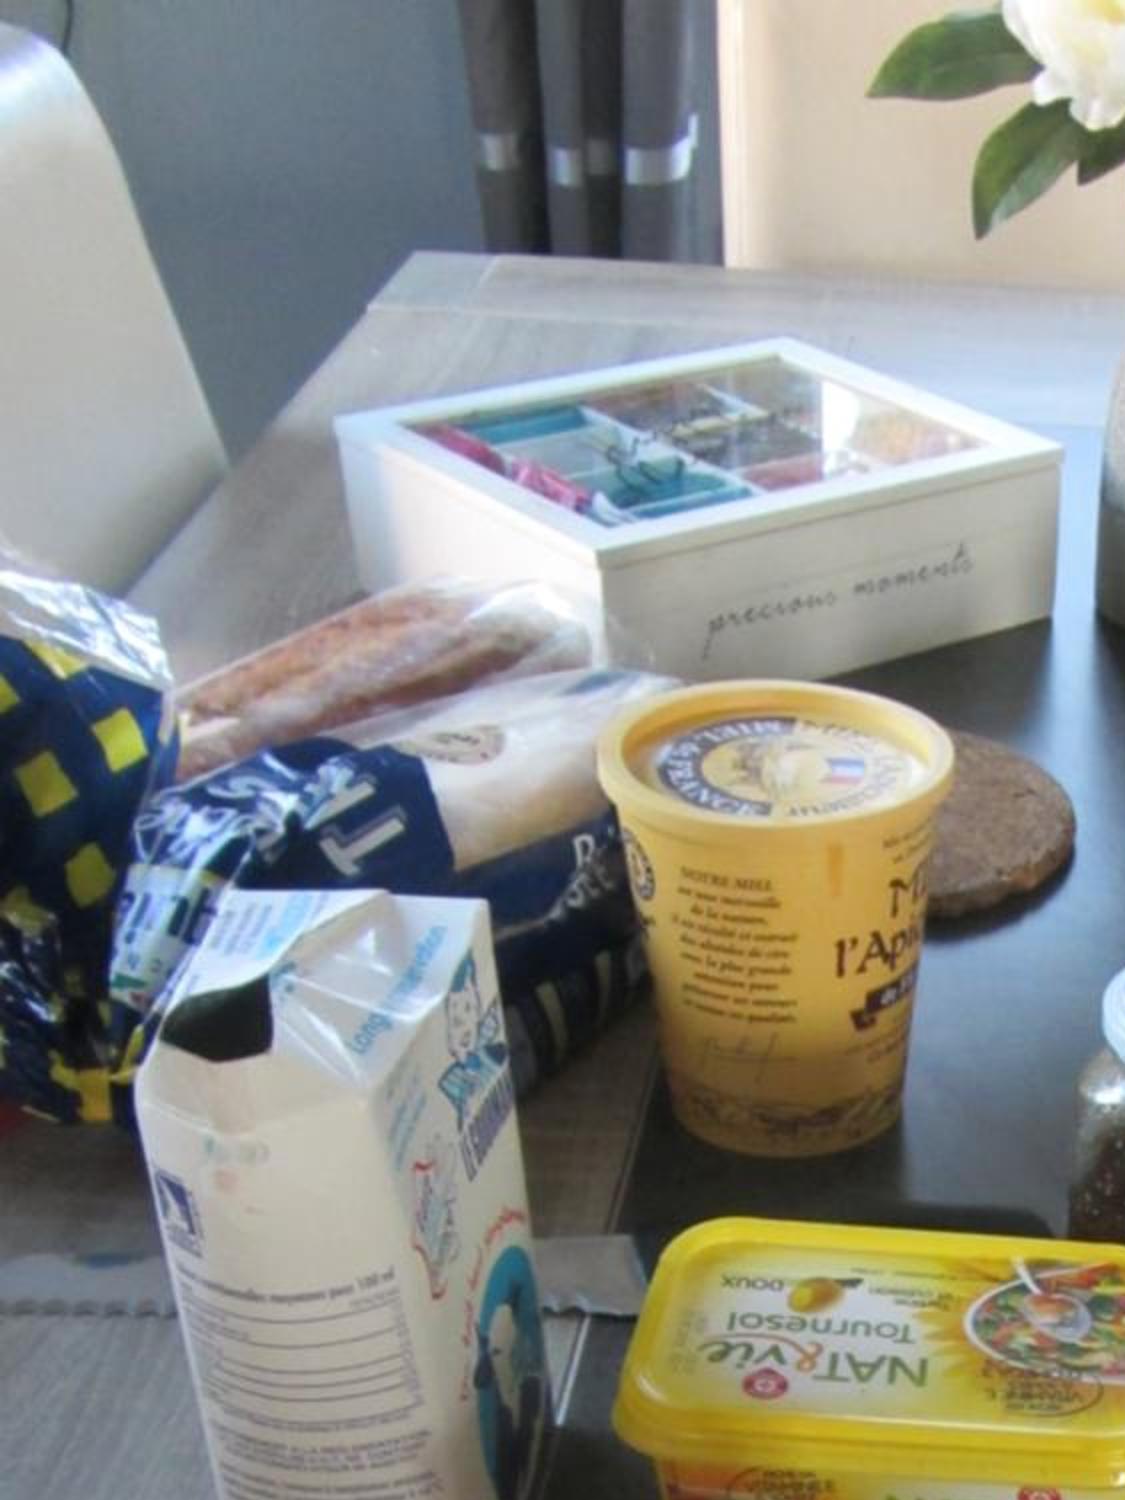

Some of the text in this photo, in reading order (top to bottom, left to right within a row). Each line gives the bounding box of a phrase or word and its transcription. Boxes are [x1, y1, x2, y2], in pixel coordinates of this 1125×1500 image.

[702, 540, 973, 660] precious moments
[722, 1275, 786, 1292] DOUX
[727, 1312, 916, 1344] Tournesol
